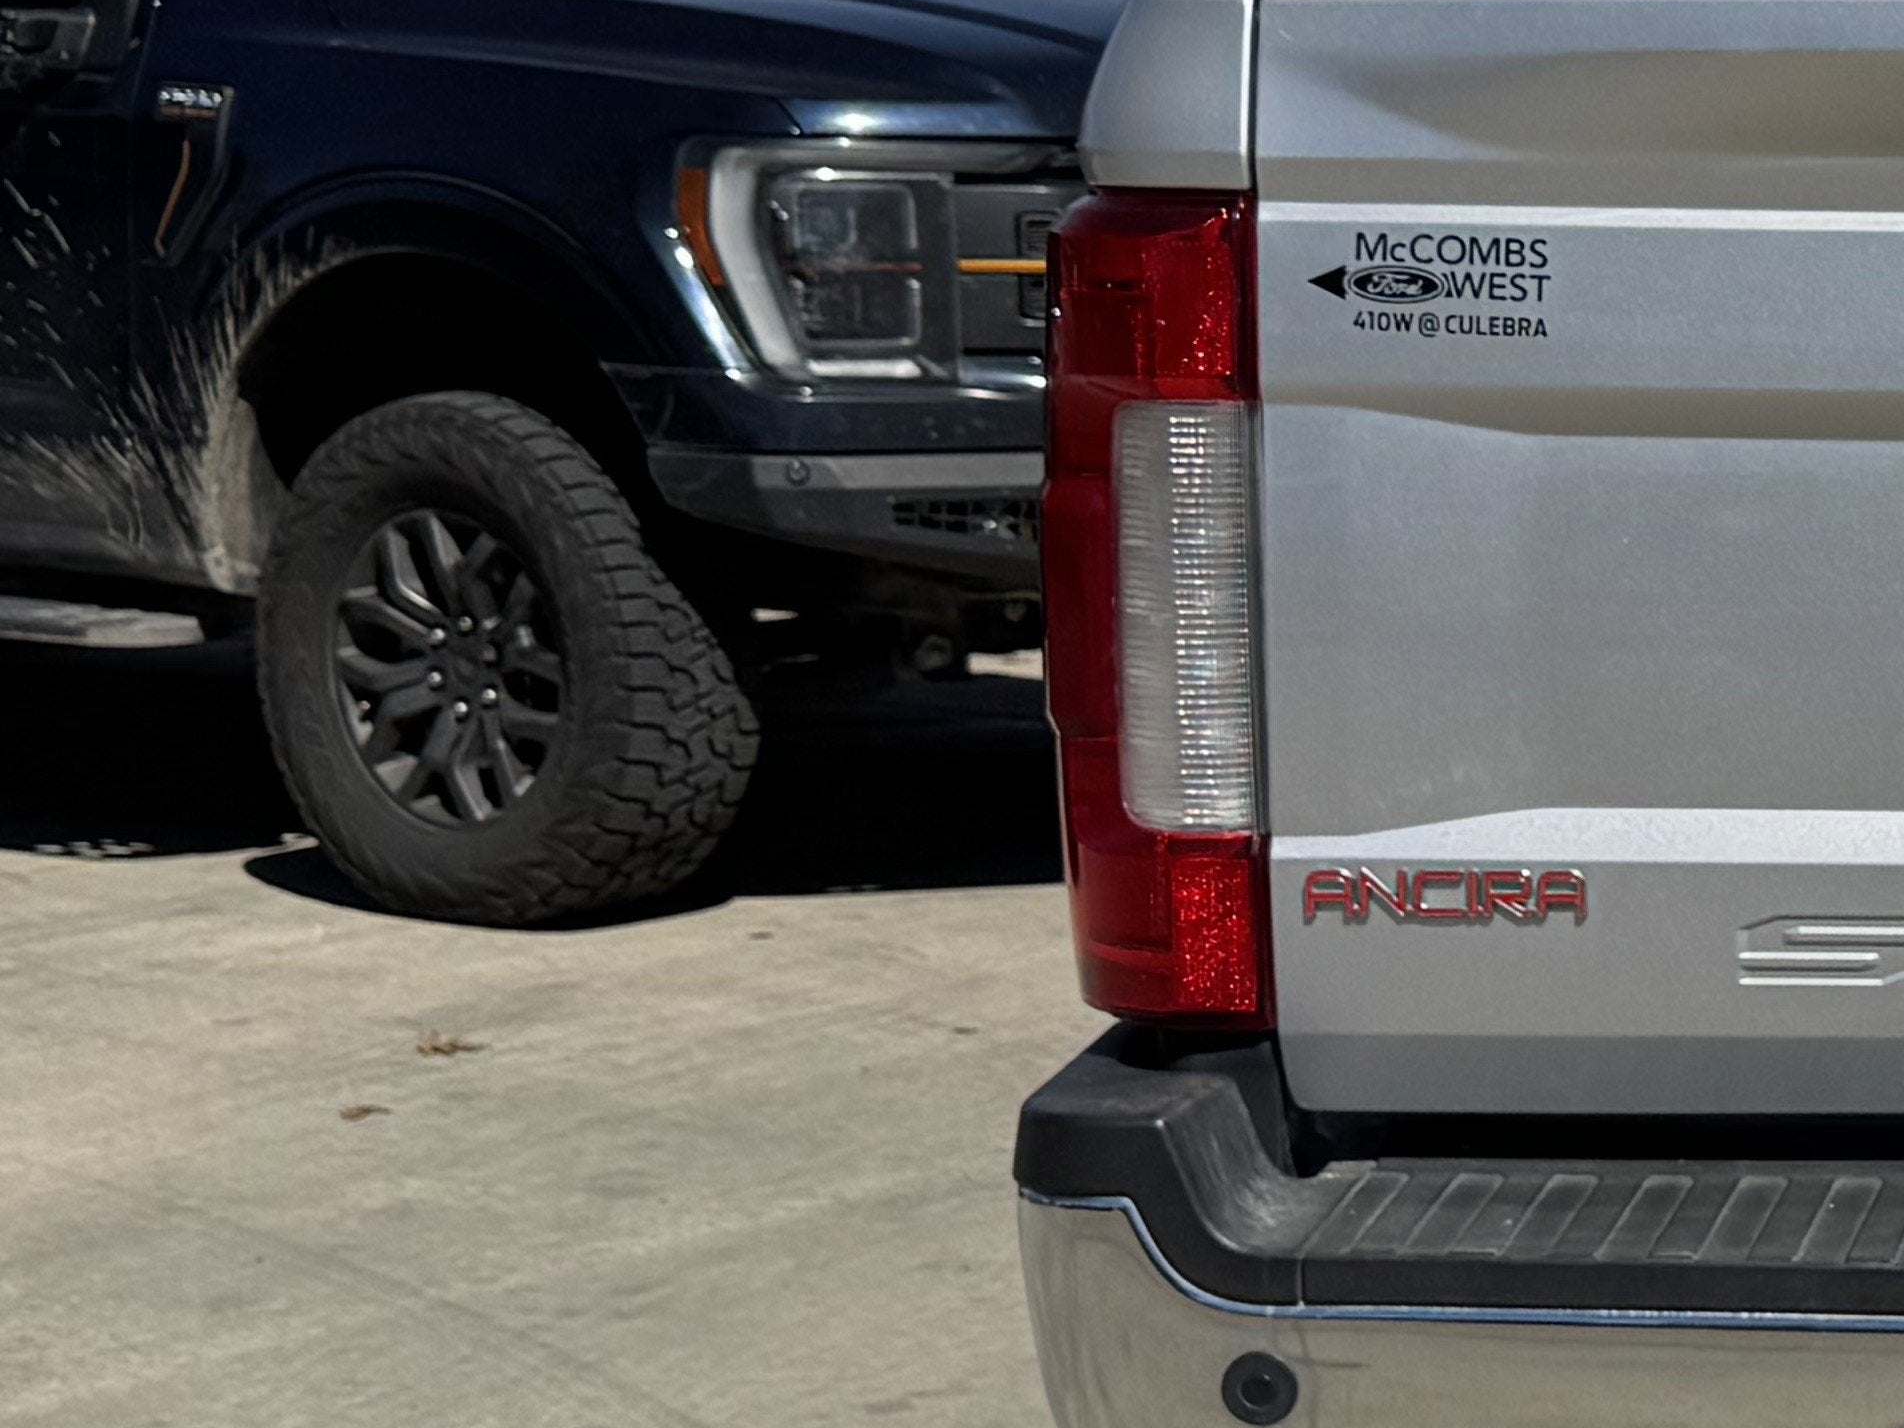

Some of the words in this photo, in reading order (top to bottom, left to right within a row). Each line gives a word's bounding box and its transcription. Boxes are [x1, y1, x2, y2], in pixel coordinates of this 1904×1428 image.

[1355, 232, 1549, 269] McCOMBS
[1366, 274, 1423, 296] Ford
[1449, 272, 1552, 302] WEST
[1302, 867, 1588, 924] ANCIRA
